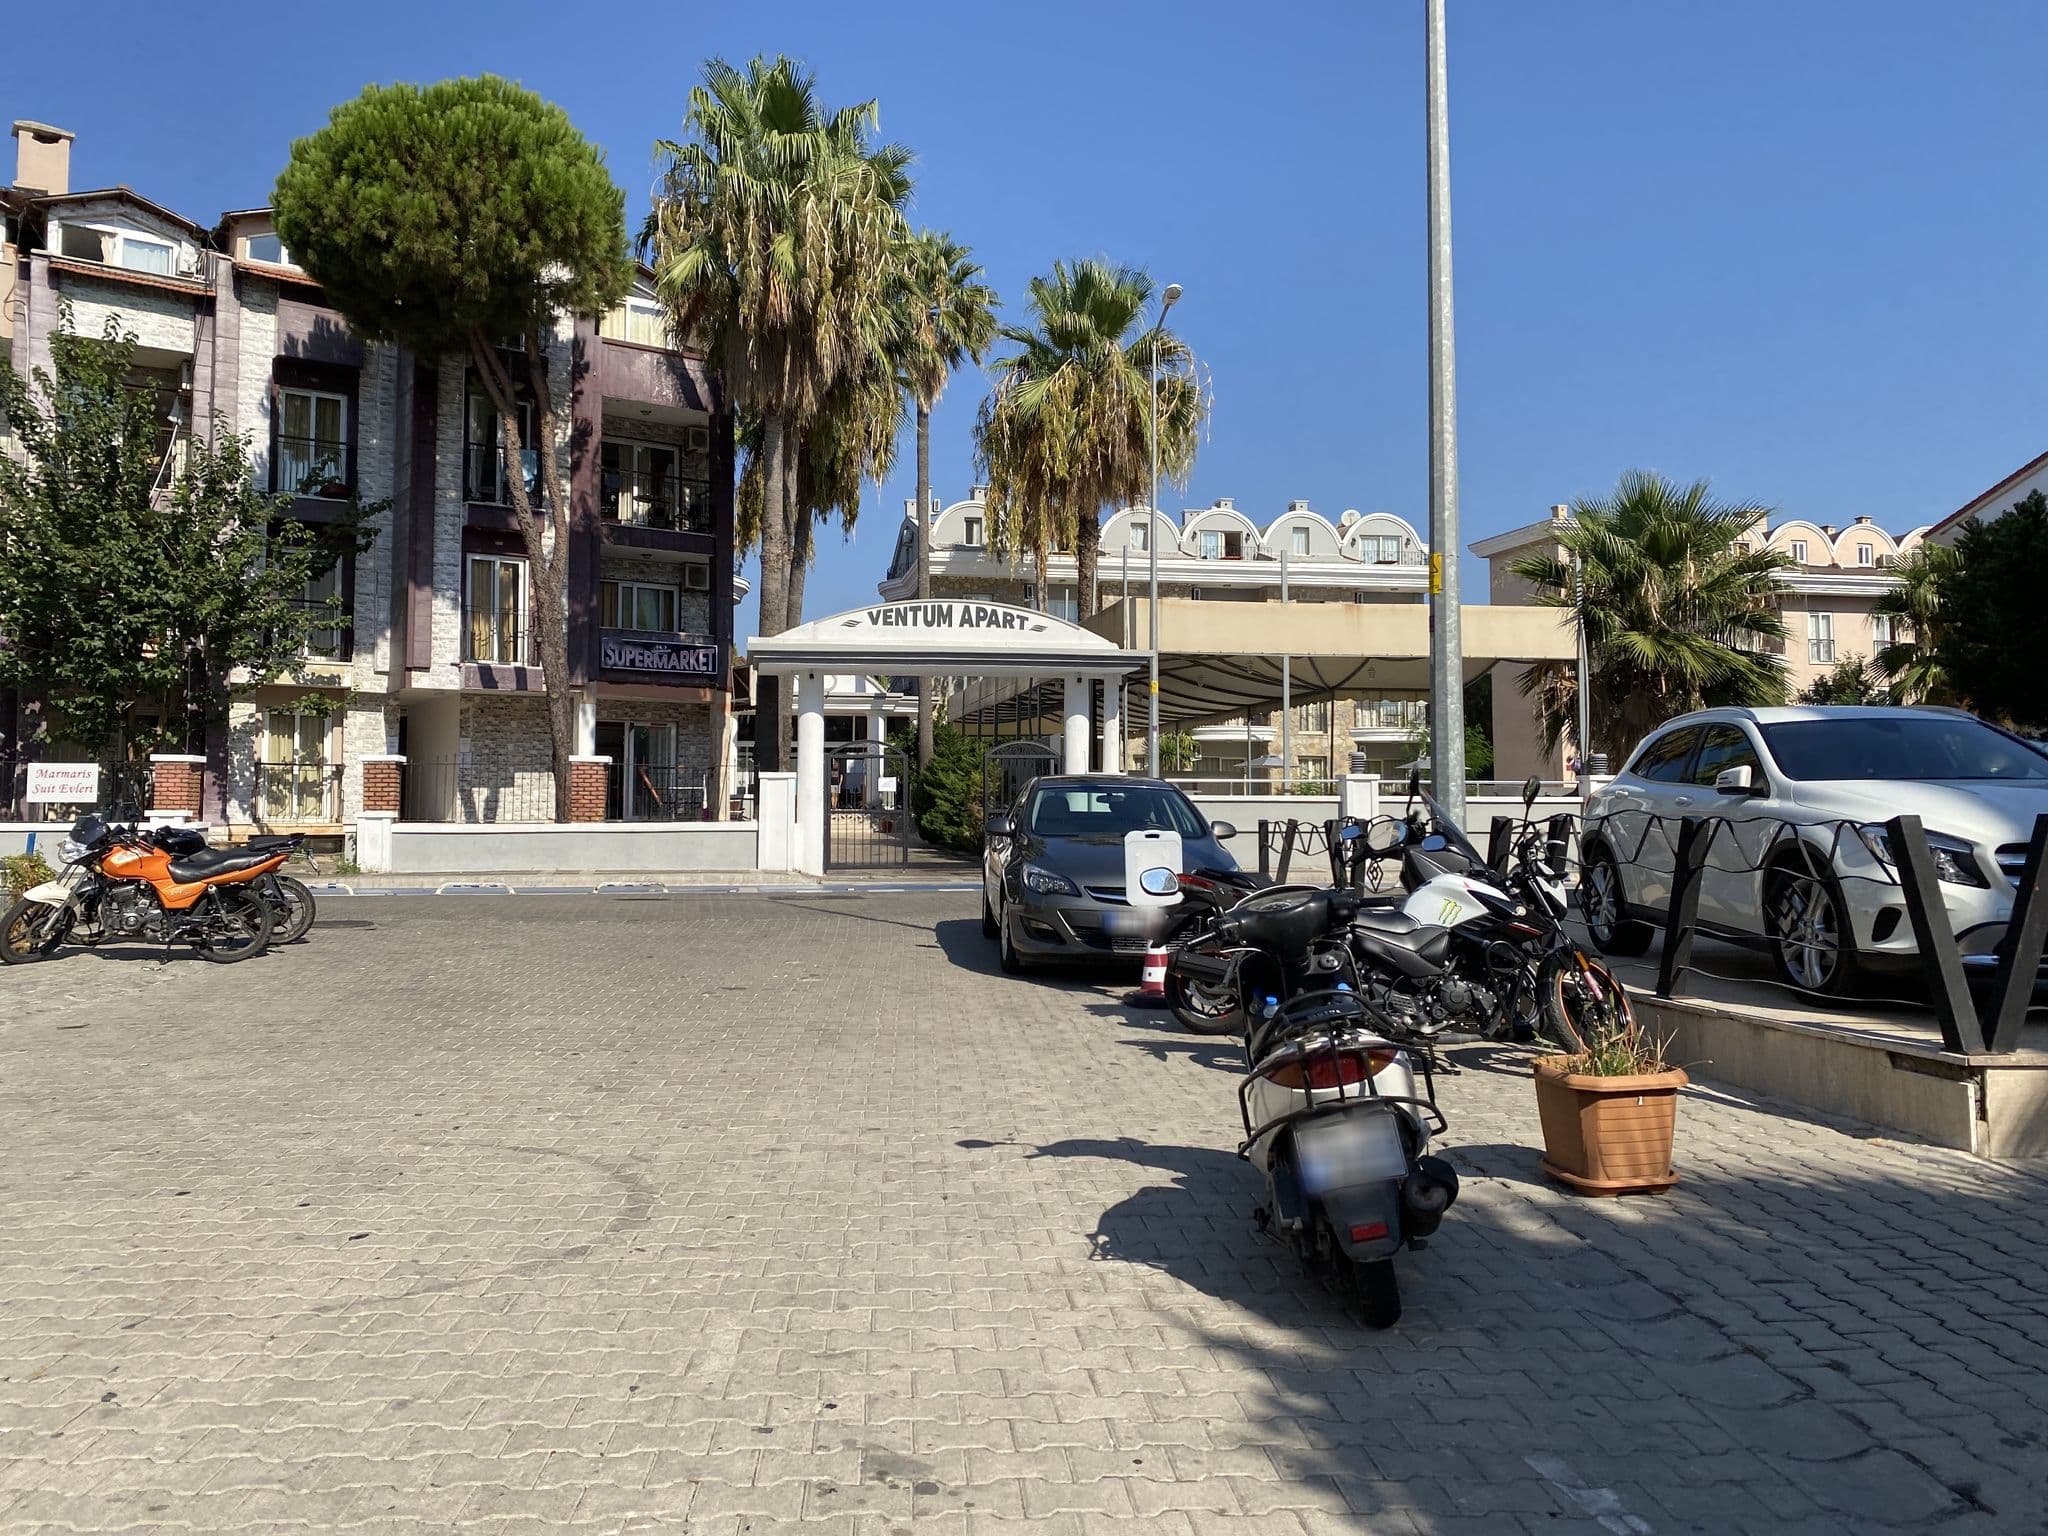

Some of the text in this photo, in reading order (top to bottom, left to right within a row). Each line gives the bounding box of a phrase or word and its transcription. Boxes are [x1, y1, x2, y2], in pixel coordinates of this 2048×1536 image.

[867, 604, 1029, 630] VENTUM APART
[606, 643, 715, 671] SUPERMARKET
[35, 769, 92, 779] Marmaris
[32, 783, 93, 794] Suit Evleri
